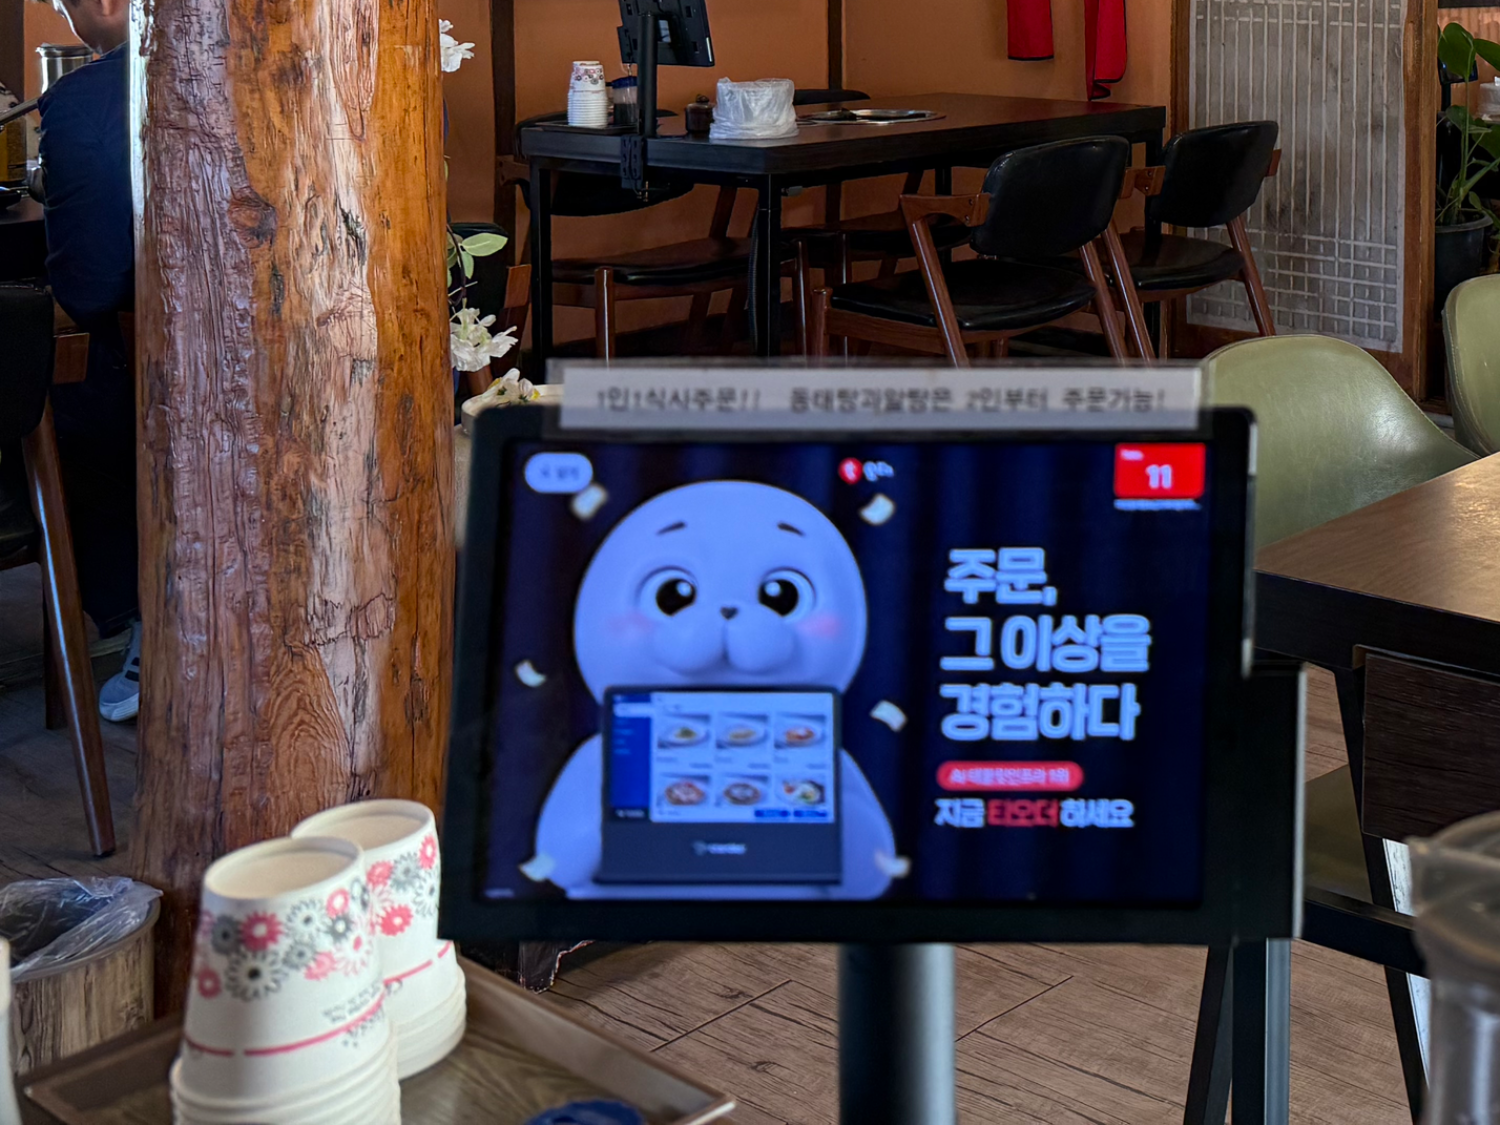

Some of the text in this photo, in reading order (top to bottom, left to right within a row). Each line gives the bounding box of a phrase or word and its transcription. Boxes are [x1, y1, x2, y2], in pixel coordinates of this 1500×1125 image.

[1146, 464, 1172, 489] 11
[944, 547, 1057, 606] 주문,
[940, 614, 1152, 673] 그 이상을
[939, 681, 1141, 741] 경험하다
[934, 798, 1135, 827] 지금 티오더 하세요
